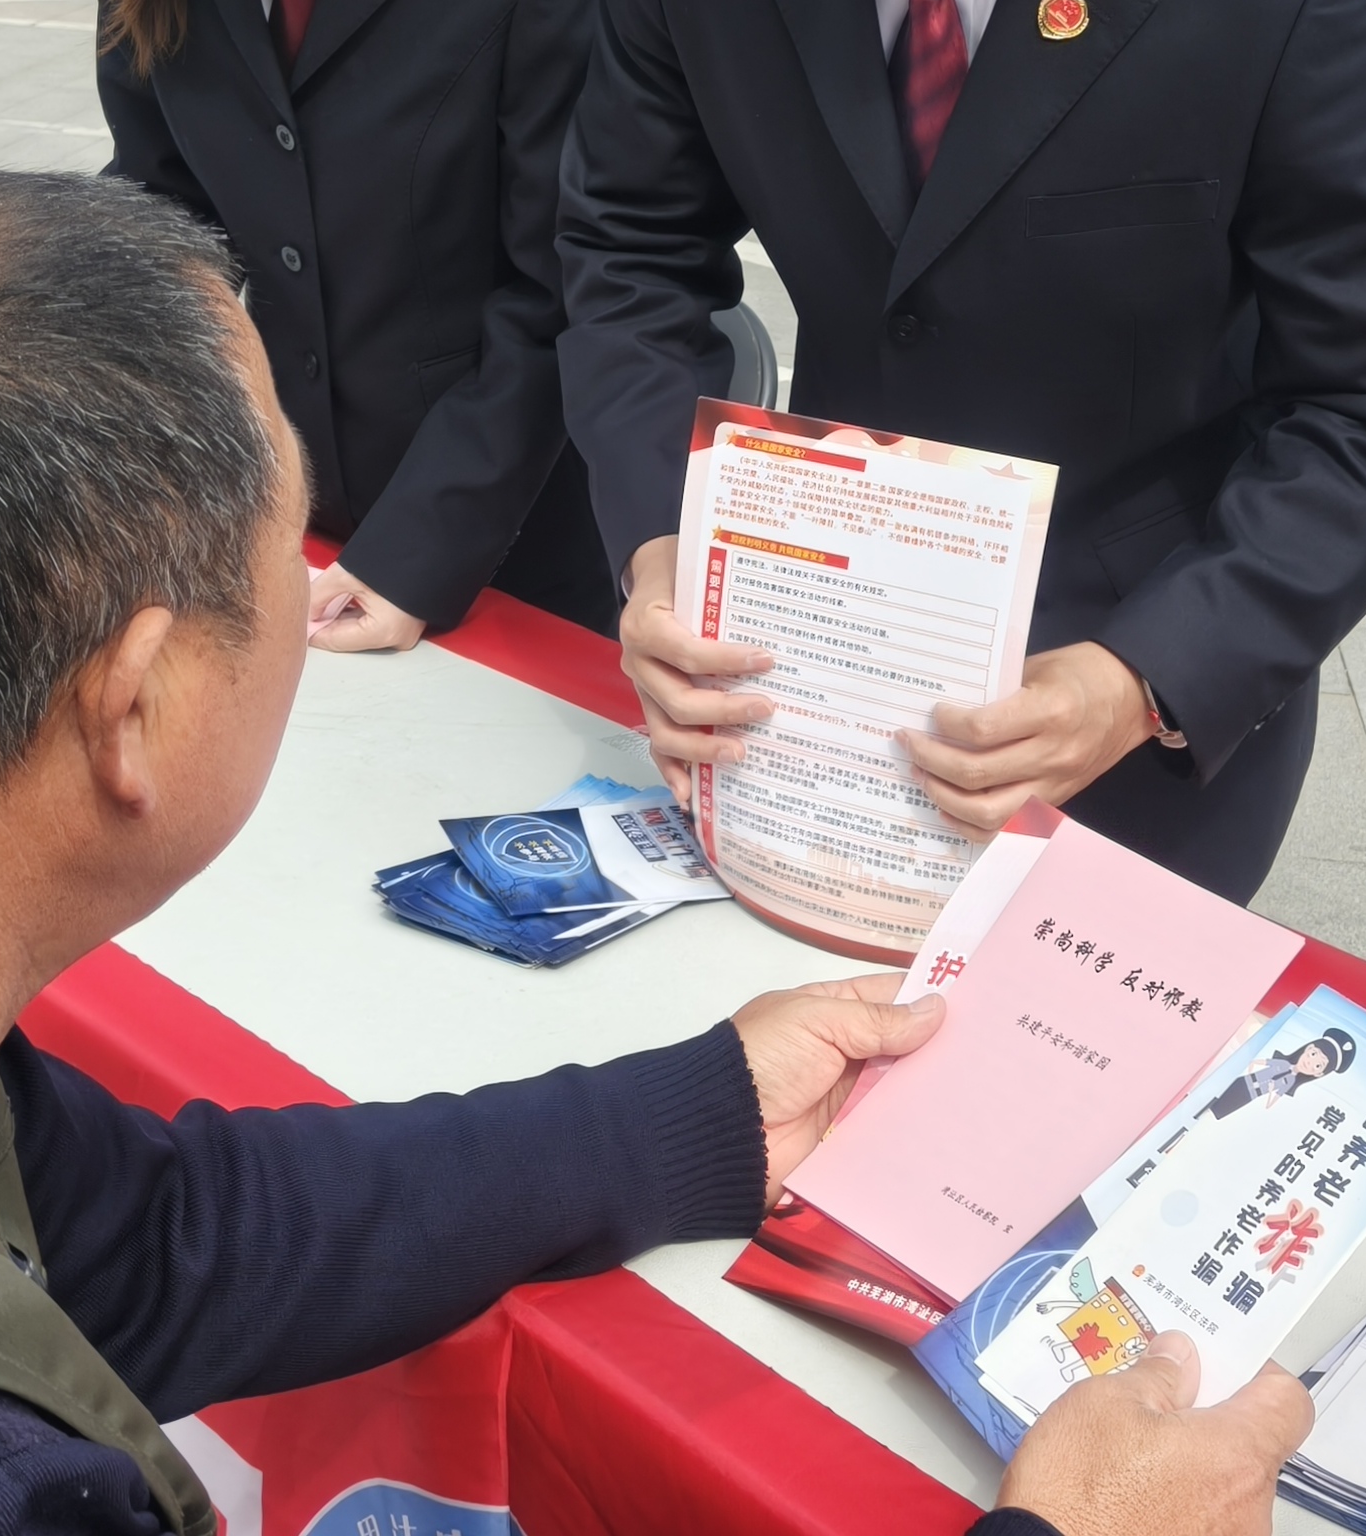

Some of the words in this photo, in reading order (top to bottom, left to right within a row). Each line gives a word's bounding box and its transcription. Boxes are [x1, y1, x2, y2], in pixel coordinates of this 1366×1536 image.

[704, 559, 722, 640] 需要履行的
[1034, 917, 1115, 973] 崇尚科学
[1119, 968, 1204, 1022] 反对邪教
[1016, 1014, 1111, 1071] 共建平安和谐家园
[1191, 1105, 1346, 1286] 常见的养老诈骗
[1143, 1273, 1220, 1335] 芜湖市湾沚区法院
